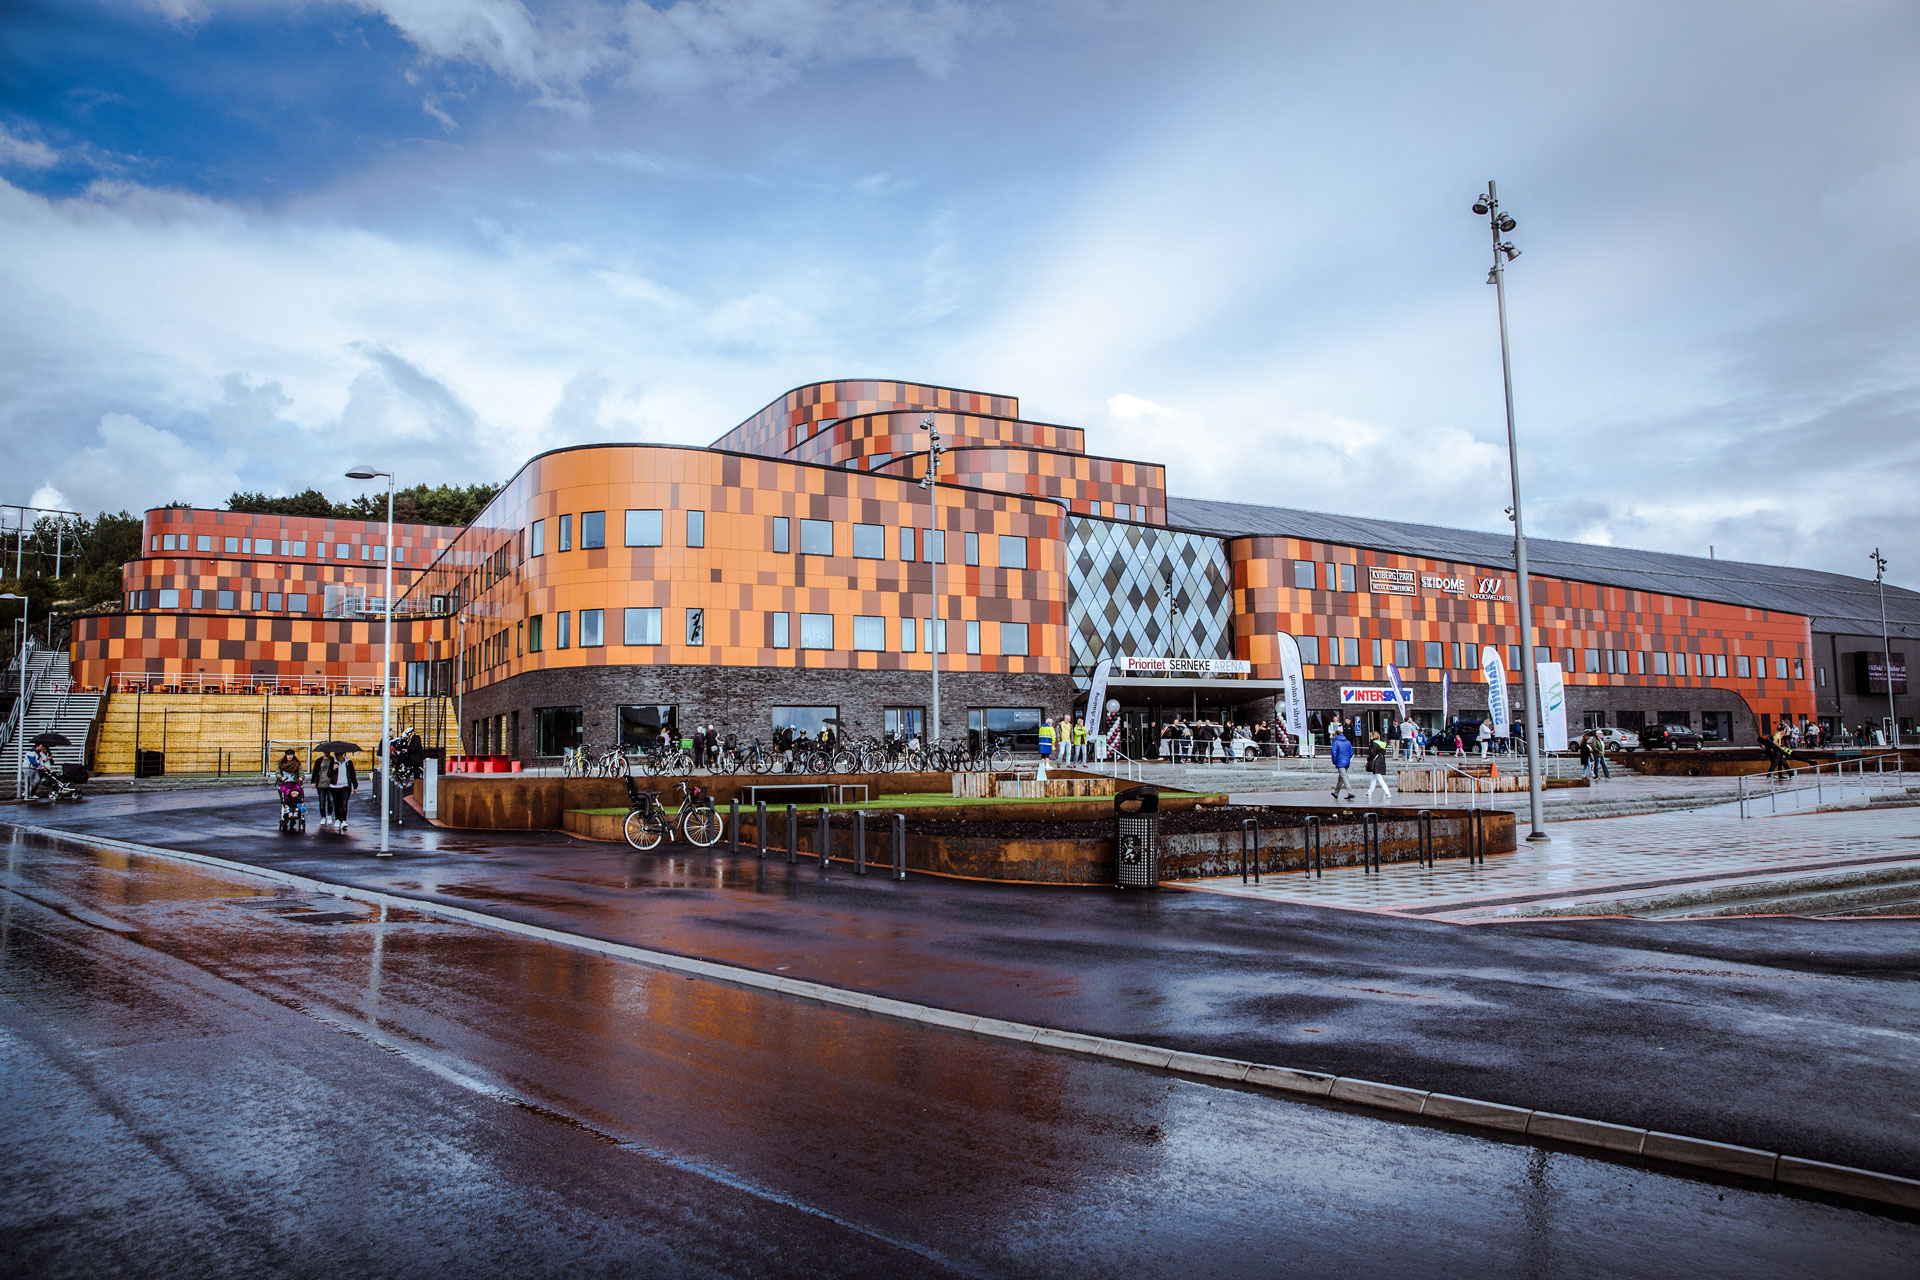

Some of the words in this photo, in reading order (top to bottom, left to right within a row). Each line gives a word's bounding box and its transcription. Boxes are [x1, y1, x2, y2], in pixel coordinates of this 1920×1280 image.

[1371, 570, 1397, 581] KVIBERG
[1399, 572, 1414, 582] PARK
[1421, 576, 1465, 591] SKIDOME
[1128, 658, 1166, 670] Prioritet
[1169, 659, 1210, 671] SERNEKE
[1213, 660, 1244, 672] ARENA
